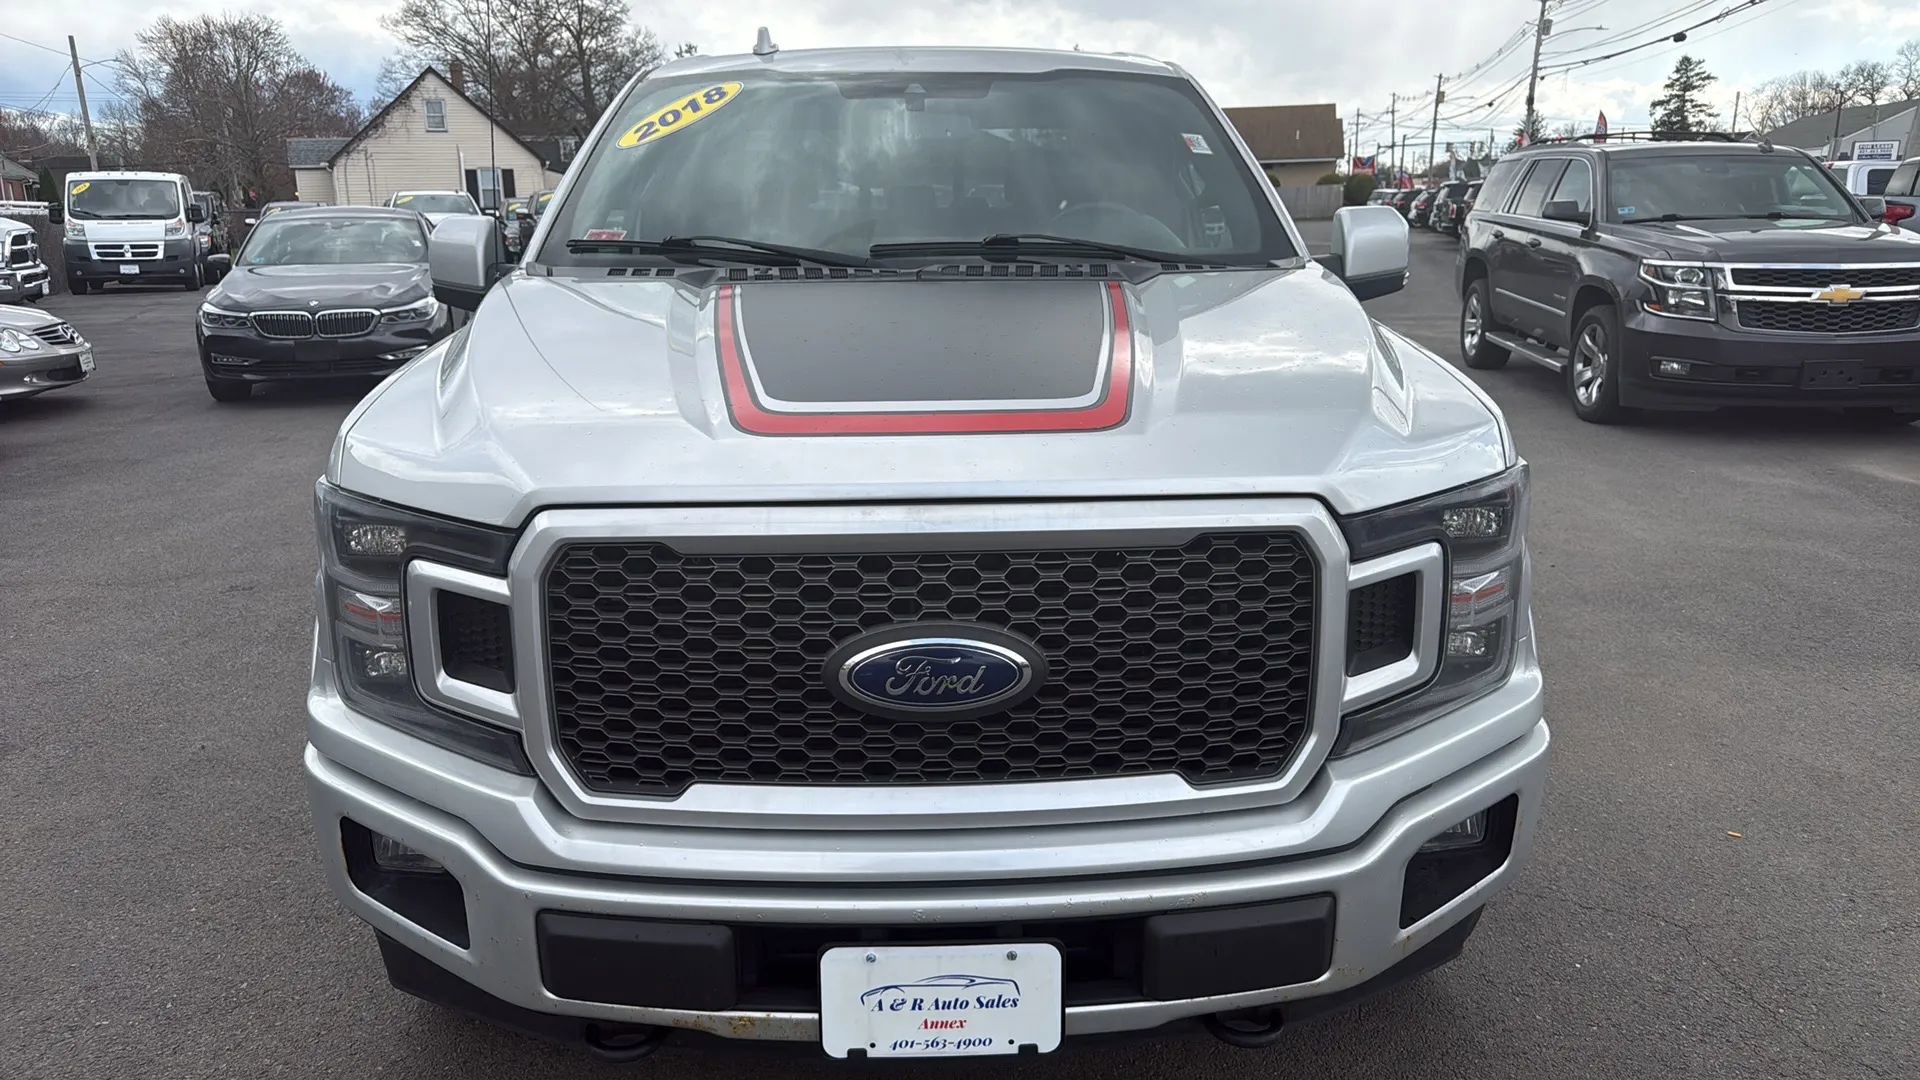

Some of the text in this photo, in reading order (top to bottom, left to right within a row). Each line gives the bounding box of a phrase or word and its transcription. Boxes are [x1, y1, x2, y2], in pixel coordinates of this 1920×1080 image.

[633, 86, 729, 142] 2018
[885, 655, 986, 696] Ford
[871, 995, 1019, 1012] A & R Auto Sales
[918, 1018, 967, 1030] Annex
[889, 1037, 993, 1051] 401-563-4900
